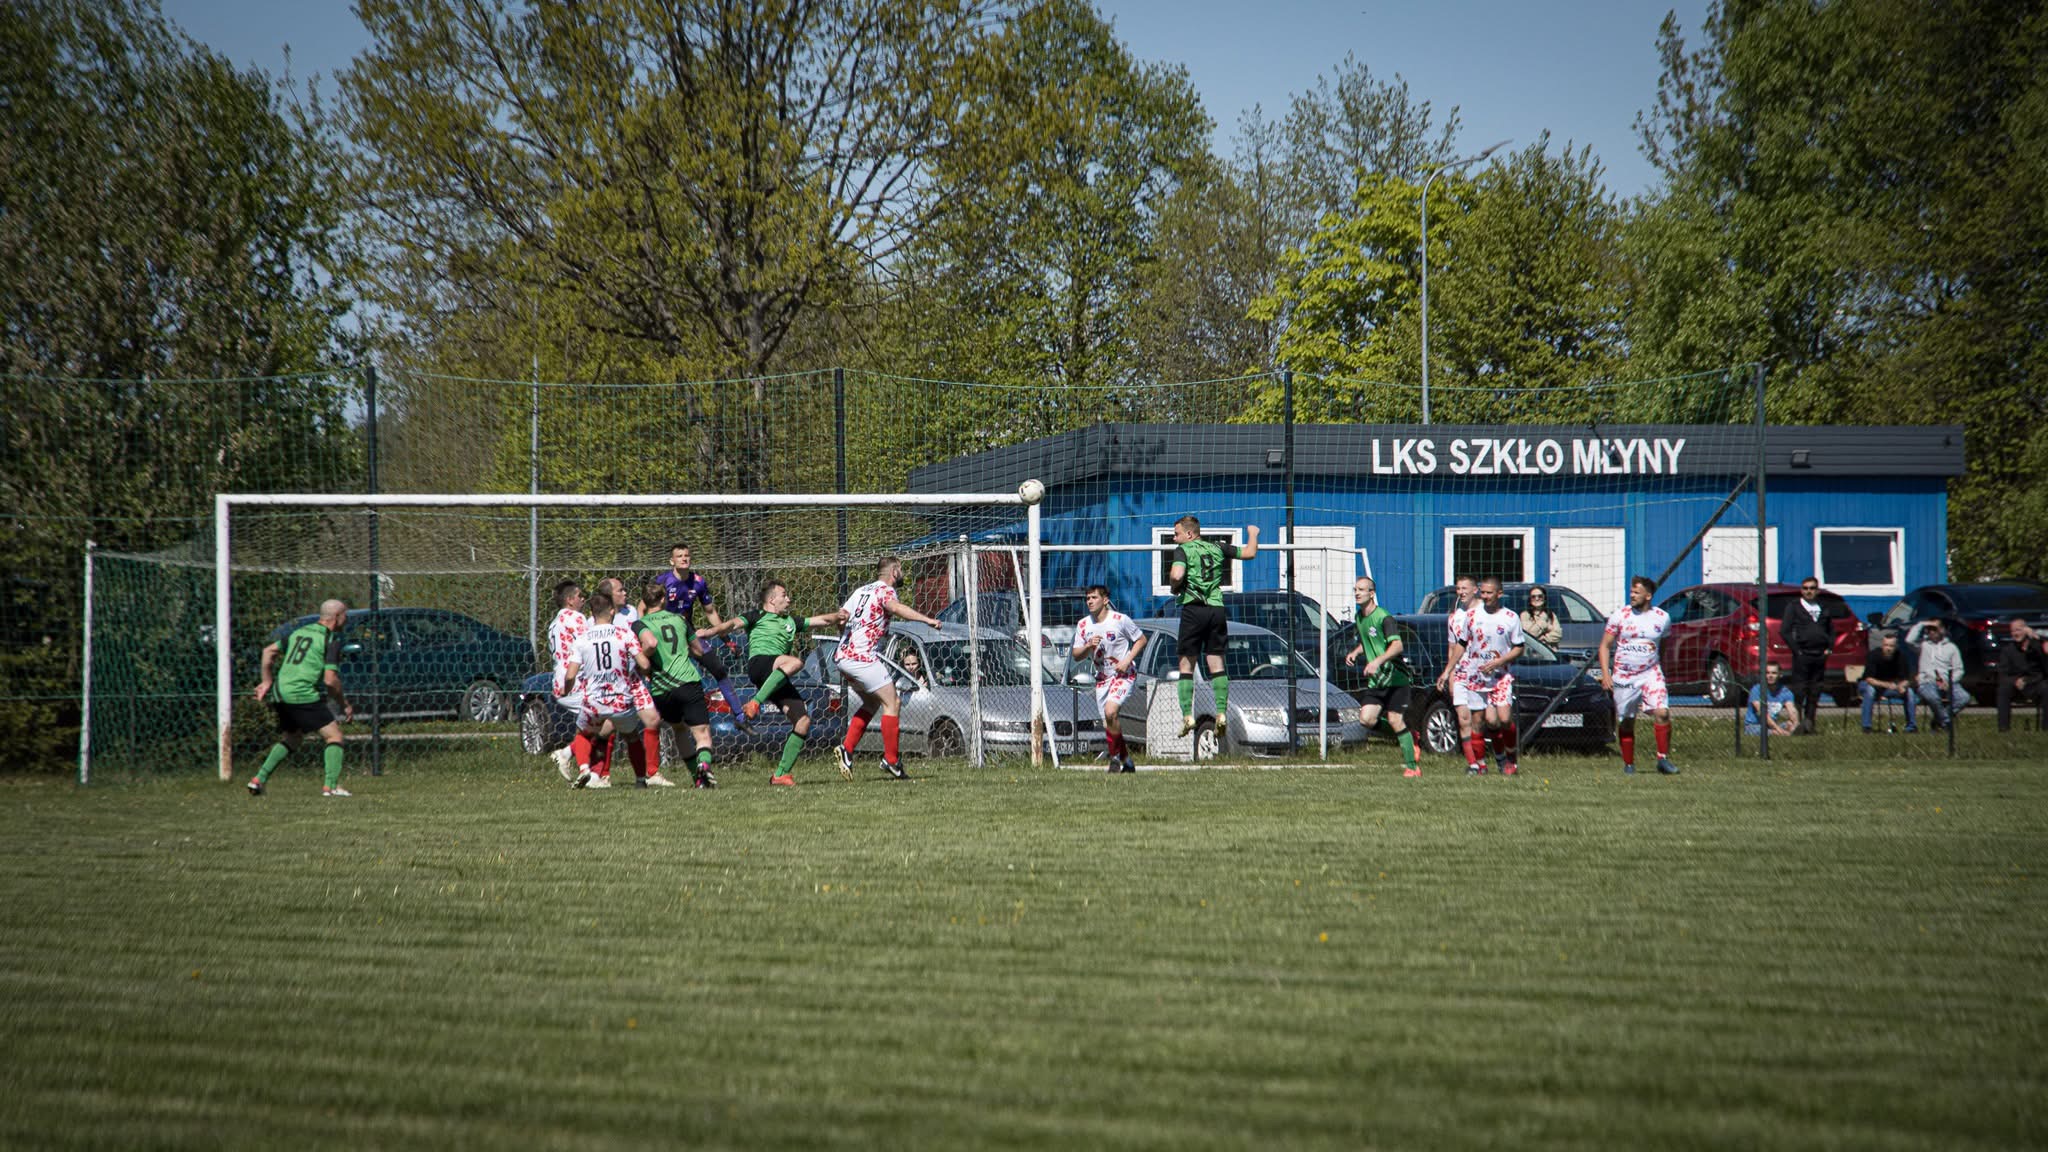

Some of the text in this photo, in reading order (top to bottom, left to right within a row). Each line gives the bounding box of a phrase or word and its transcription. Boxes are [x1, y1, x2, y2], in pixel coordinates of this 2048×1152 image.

[1371, 438, 1686, 475] LKS SZKŁO MŁYNY
[289, 636, 313, 665] 18
[661, 624, 678, 655] 9
[592, 641, 612, 671] 18
